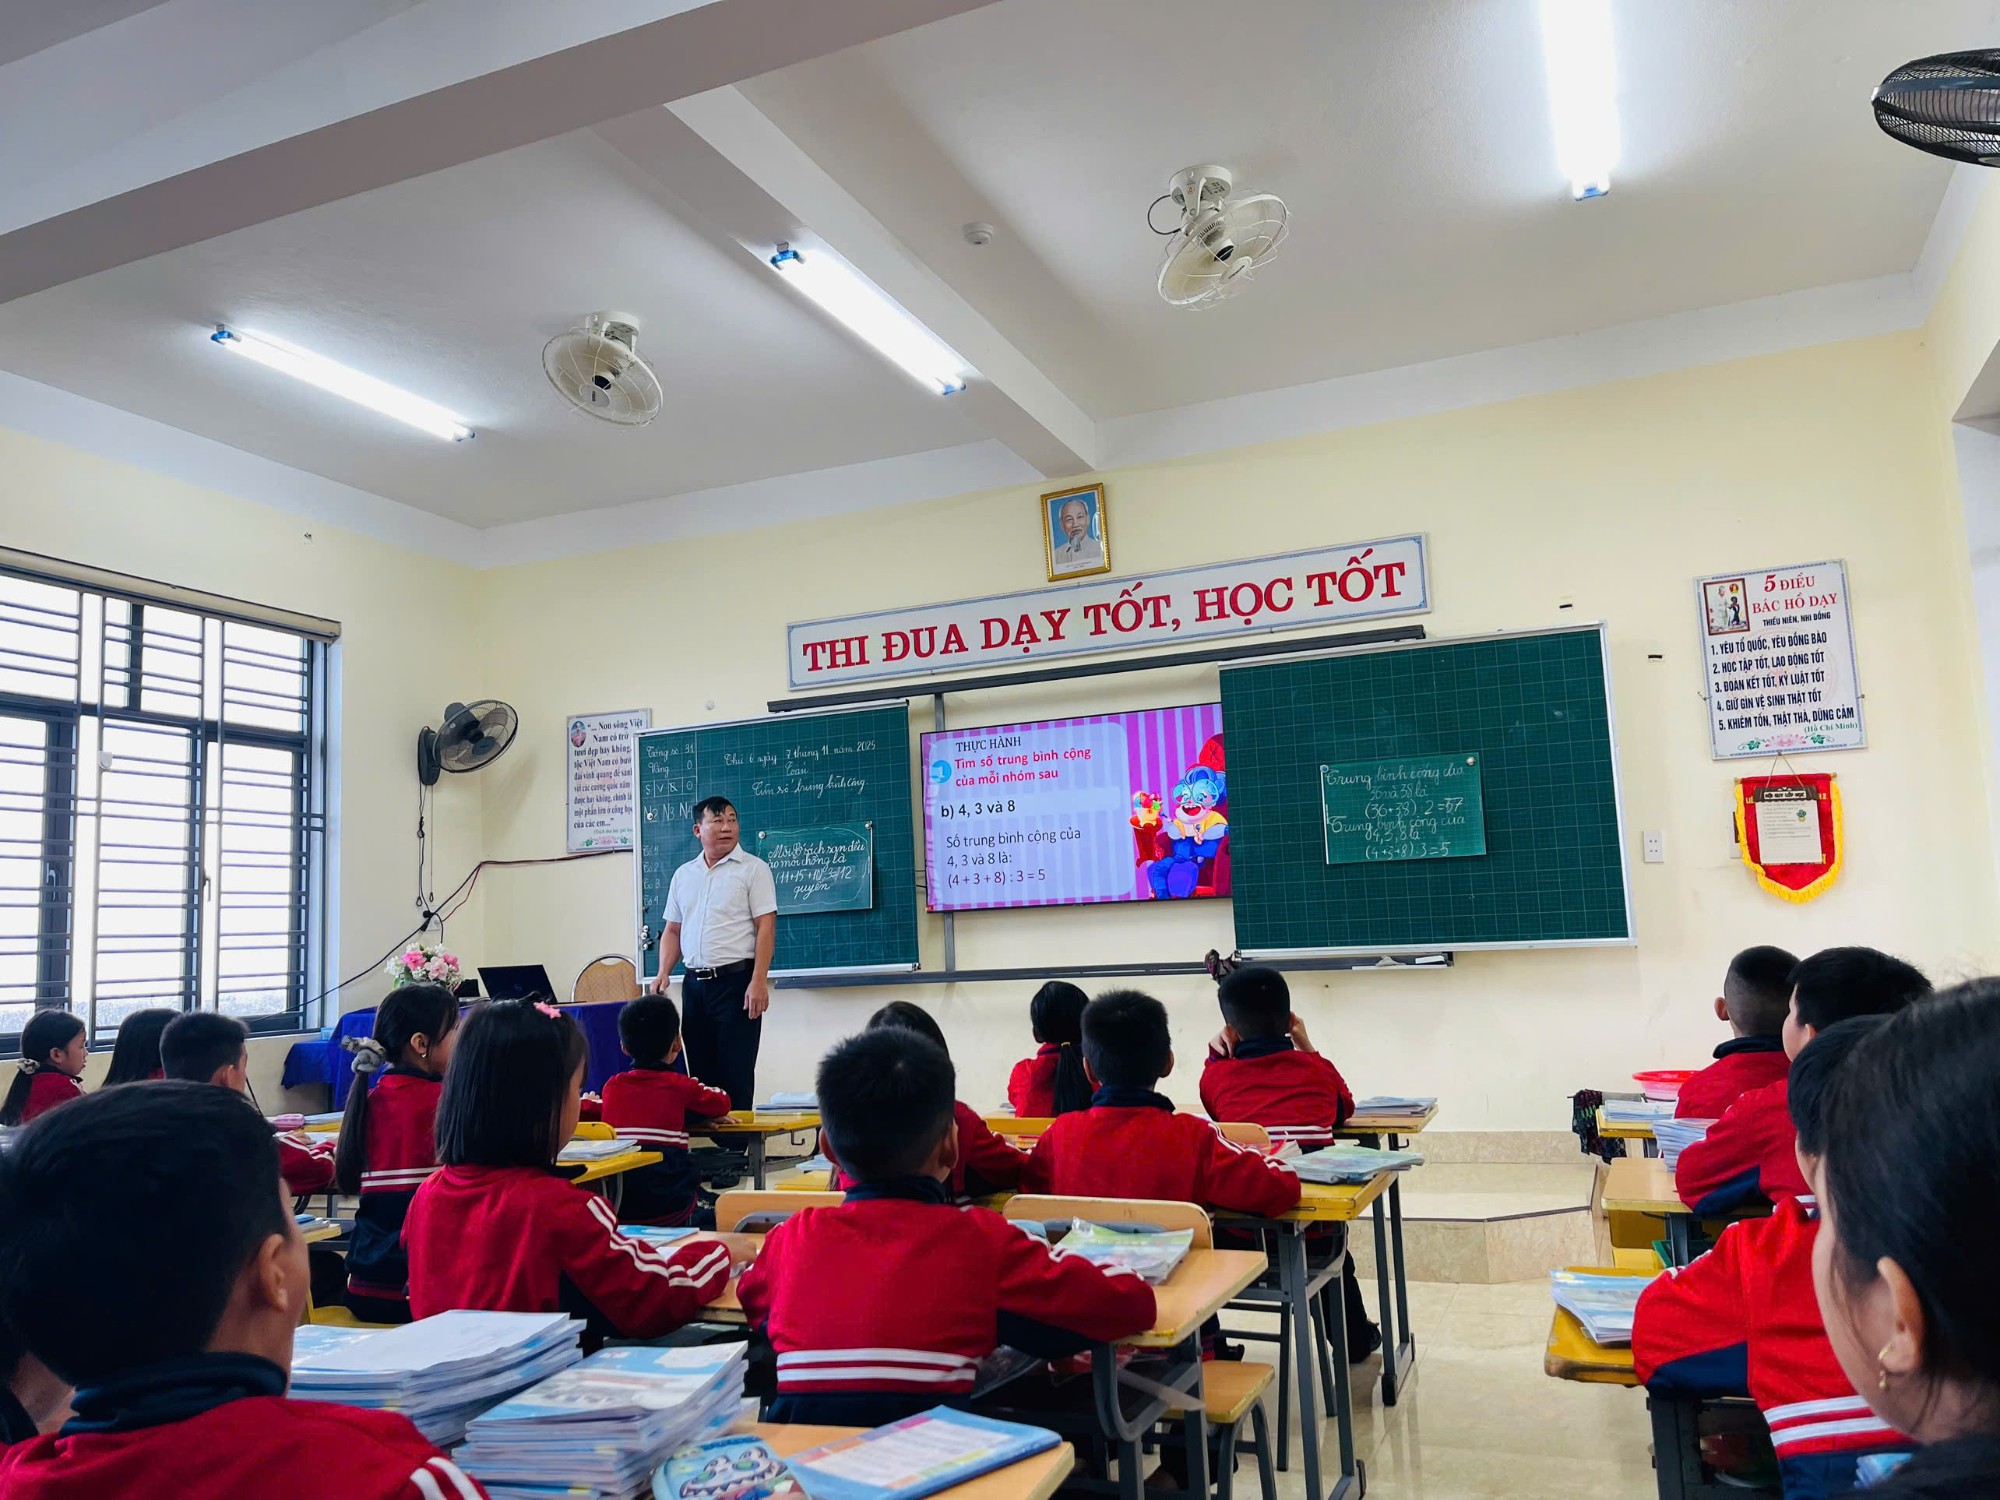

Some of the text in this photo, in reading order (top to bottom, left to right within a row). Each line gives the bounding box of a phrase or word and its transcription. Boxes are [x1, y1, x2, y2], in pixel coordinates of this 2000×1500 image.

[1764, 572, 1815, 592] 5 ĐIỀU
[803, 549, 1406, 673] THI ĐUA DẠY TỐT, HỌC TỐT
[1753, 592, 1838, 614] BÁC HỒ DẠY
[1763, 611, 1831, 626] THIẾU NIÊN, NHI ĐỒNG
[1711, 630, 1827, 655] 1. YÊU TỔ QUỐC, YÊU ĐỒNG BÀO
[1713, 649, 1825, 676] 2. HỌC TẬP TỐT, LAO ĐỘNG TỐT
[1715, 668, 1825, 693] 3. ĐOÀN KẾT TỐT, KỶ LUẬT TỐT
[1717, 687, 1822, 711] 4. GIỮ GÌN VỆ SINH THẬT TỐT
[599, 722, 611, 730] Non
[630, 718, 643, 727] Việt
[1719, 704, 1854, 730] 5. KHIÊM TỐN, THẬT THÀ, DŨNG CẢM
[593, 734, 608, 743] Nam
[956, 736, 1021, 752] THỰC HÀNH
[685, 744, 694, 754] 31
[793, 745, 819, 761] tháng
[834, 745, 853, 754] năm
[857, 740, 876, 751] 2025
[955, 748, 1091, 770] Tìm số trung bình cộng
[956, 769, 1058, 787] của mỗi nhóm sau
[941, 800, 1015, 819] b) 4, 3 và 8
[947, 827, 1081, 849] Số trung bình cộng của
[947, 851, 1012, 868] 4, 3 và 8 là:
[973, 873, 981, 885] 3
[1017, 870, 1024, 882] 3
[1039, 869, 1046, 881] 5
